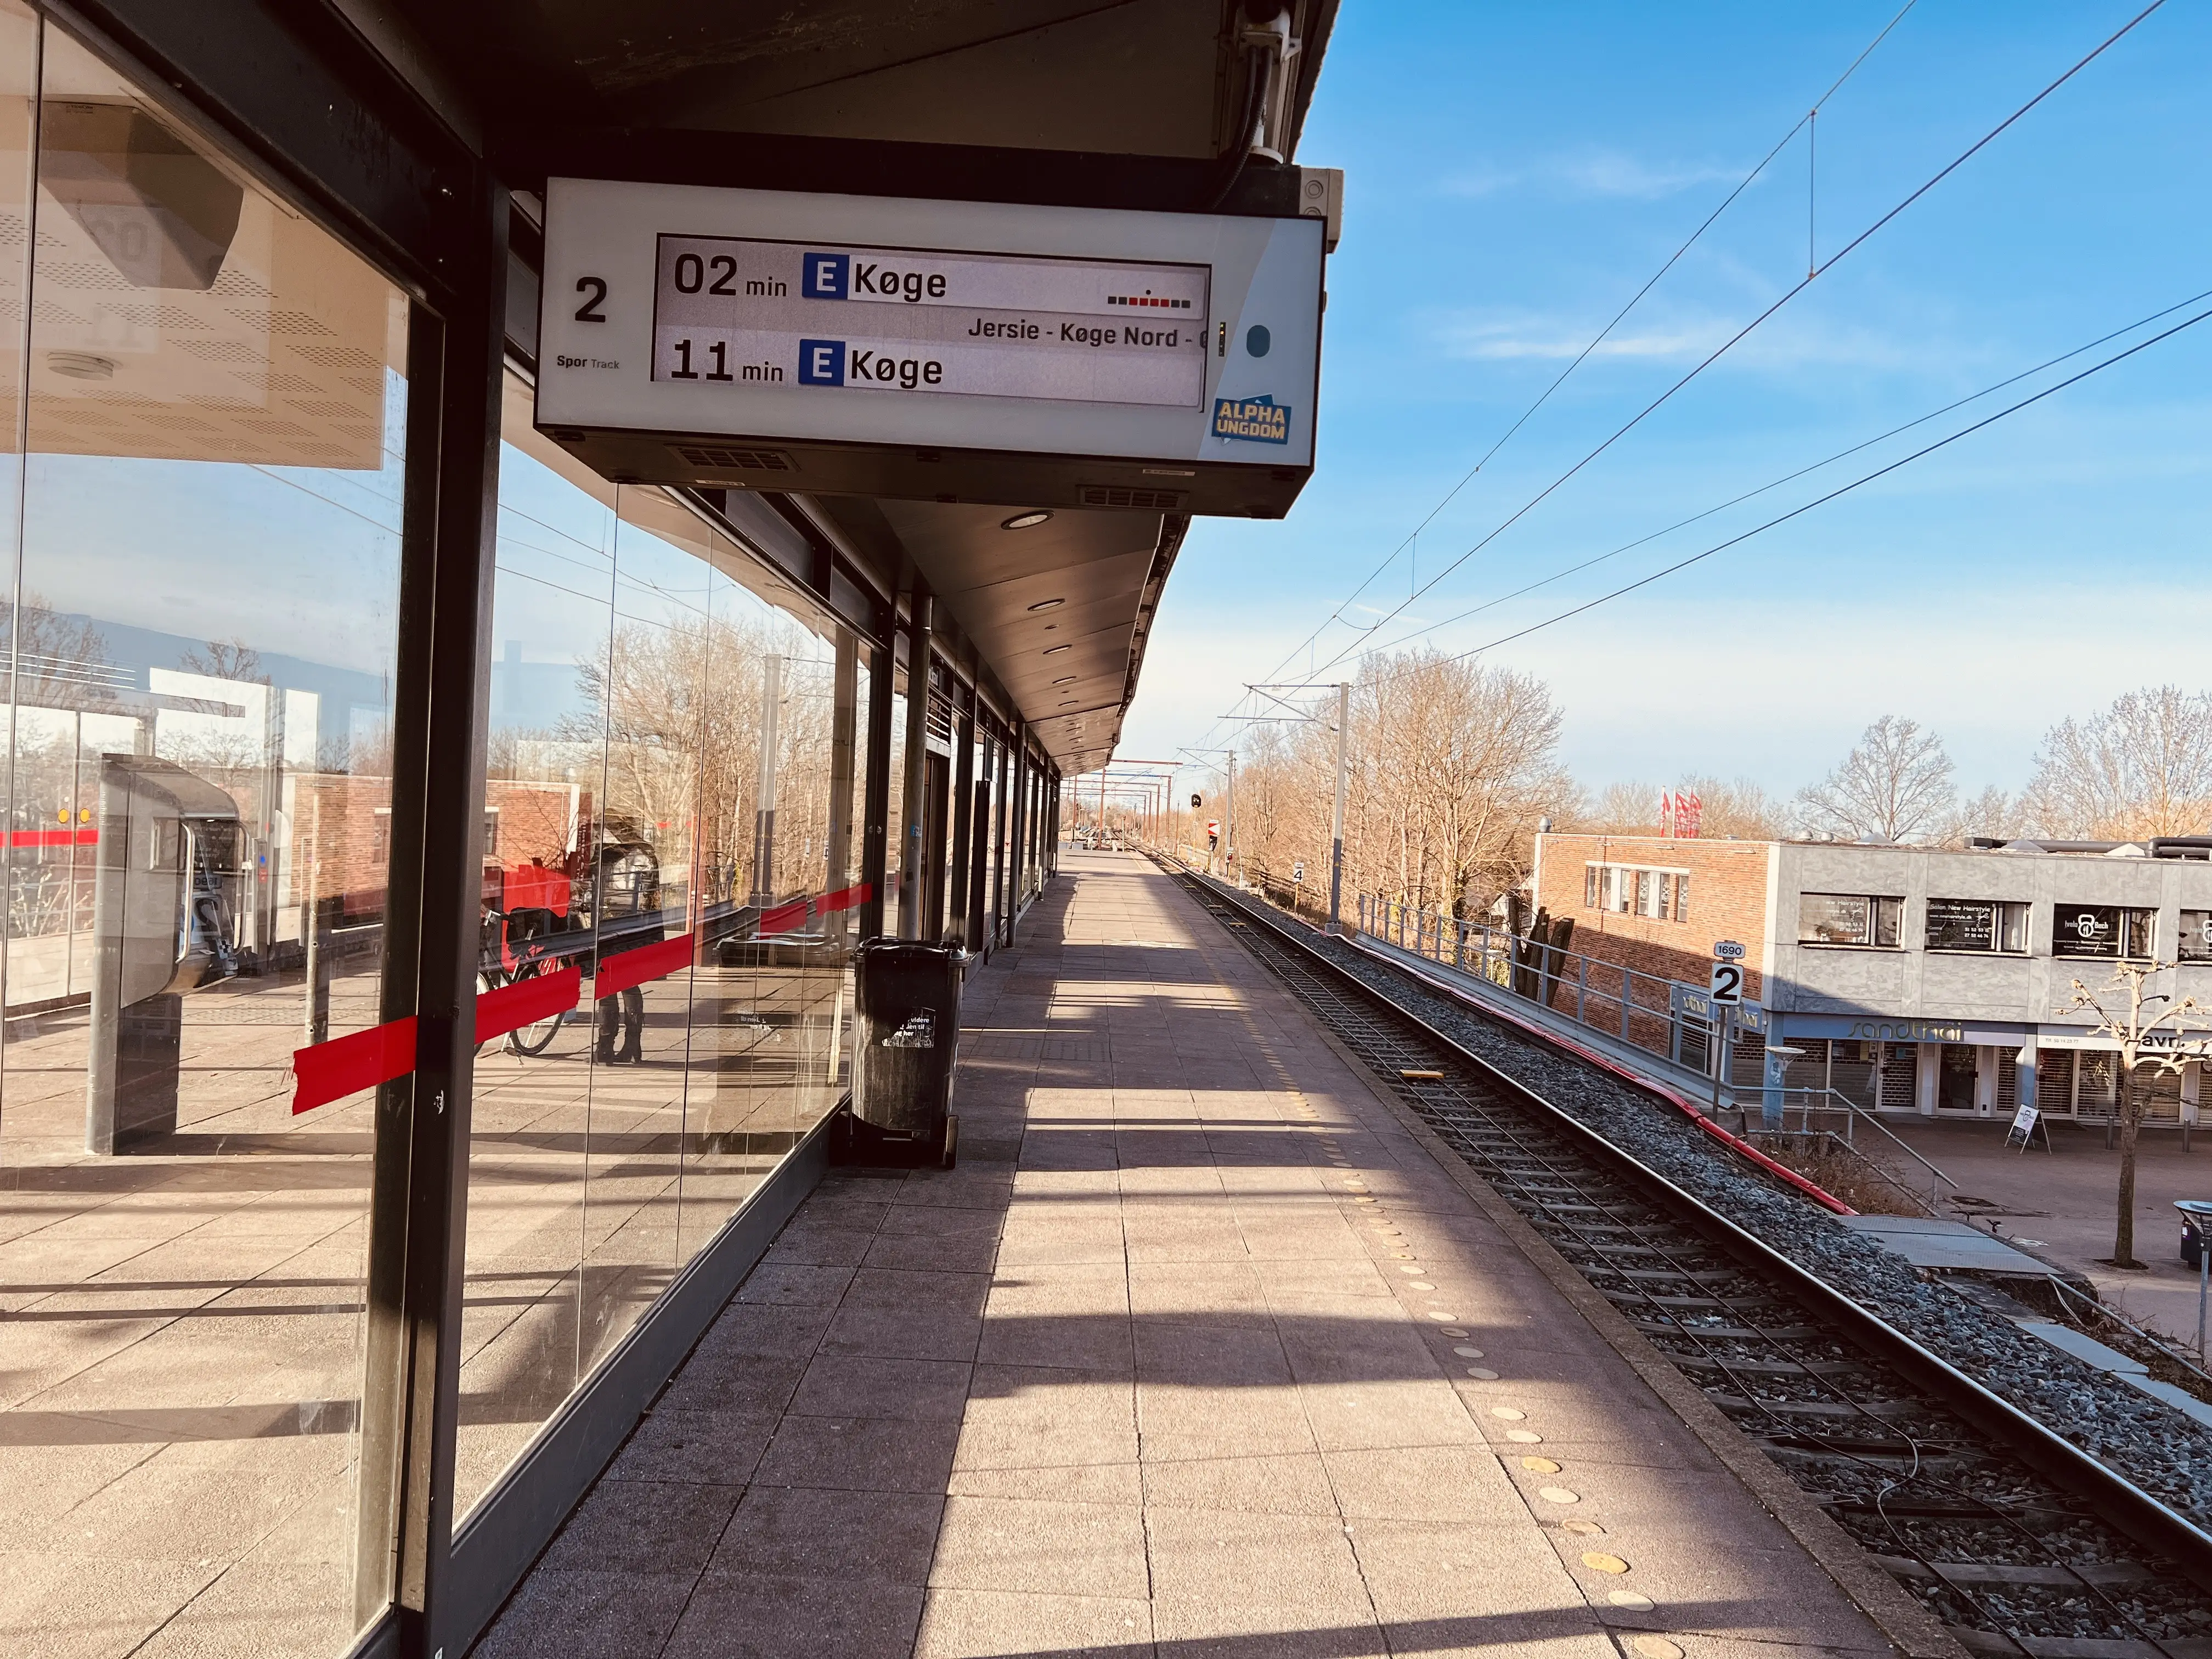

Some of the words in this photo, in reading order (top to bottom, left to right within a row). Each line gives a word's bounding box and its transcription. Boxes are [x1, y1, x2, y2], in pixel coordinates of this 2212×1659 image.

[674, 253, 738, 296] 02
[746, 275, 787, 297] min
[815, 260, 837, 292] E
[855, 263, 947, 303] Køge
[574, 275, 607, 323] 2
[968, 318, 1040, 340] Jersie
[1060, 323, 1117, 348] Køge
[1124, 326, 1179, 348] Nord
[557, 354, 588, 369] Spor
[590, 358, 620, 370] Track
[670, 338, 733, 382] 11
[742, 360, 783, 382] min
[812, 347, 833, 378] E
[851, 349, 943, 389] Køge
[1219, 402, 1285, 424] ALPHA
[1217, 419, 1285, 439] UNGDOM
[1294, 870, 1302, 881] 4
[1963, 905, 1991, 913] Hairstyle
[1718, 945, 1742, 956] 1690
[1713, 967, 1740, 1001] 2
[1848, 1021, 1962, 1042] sandthai
